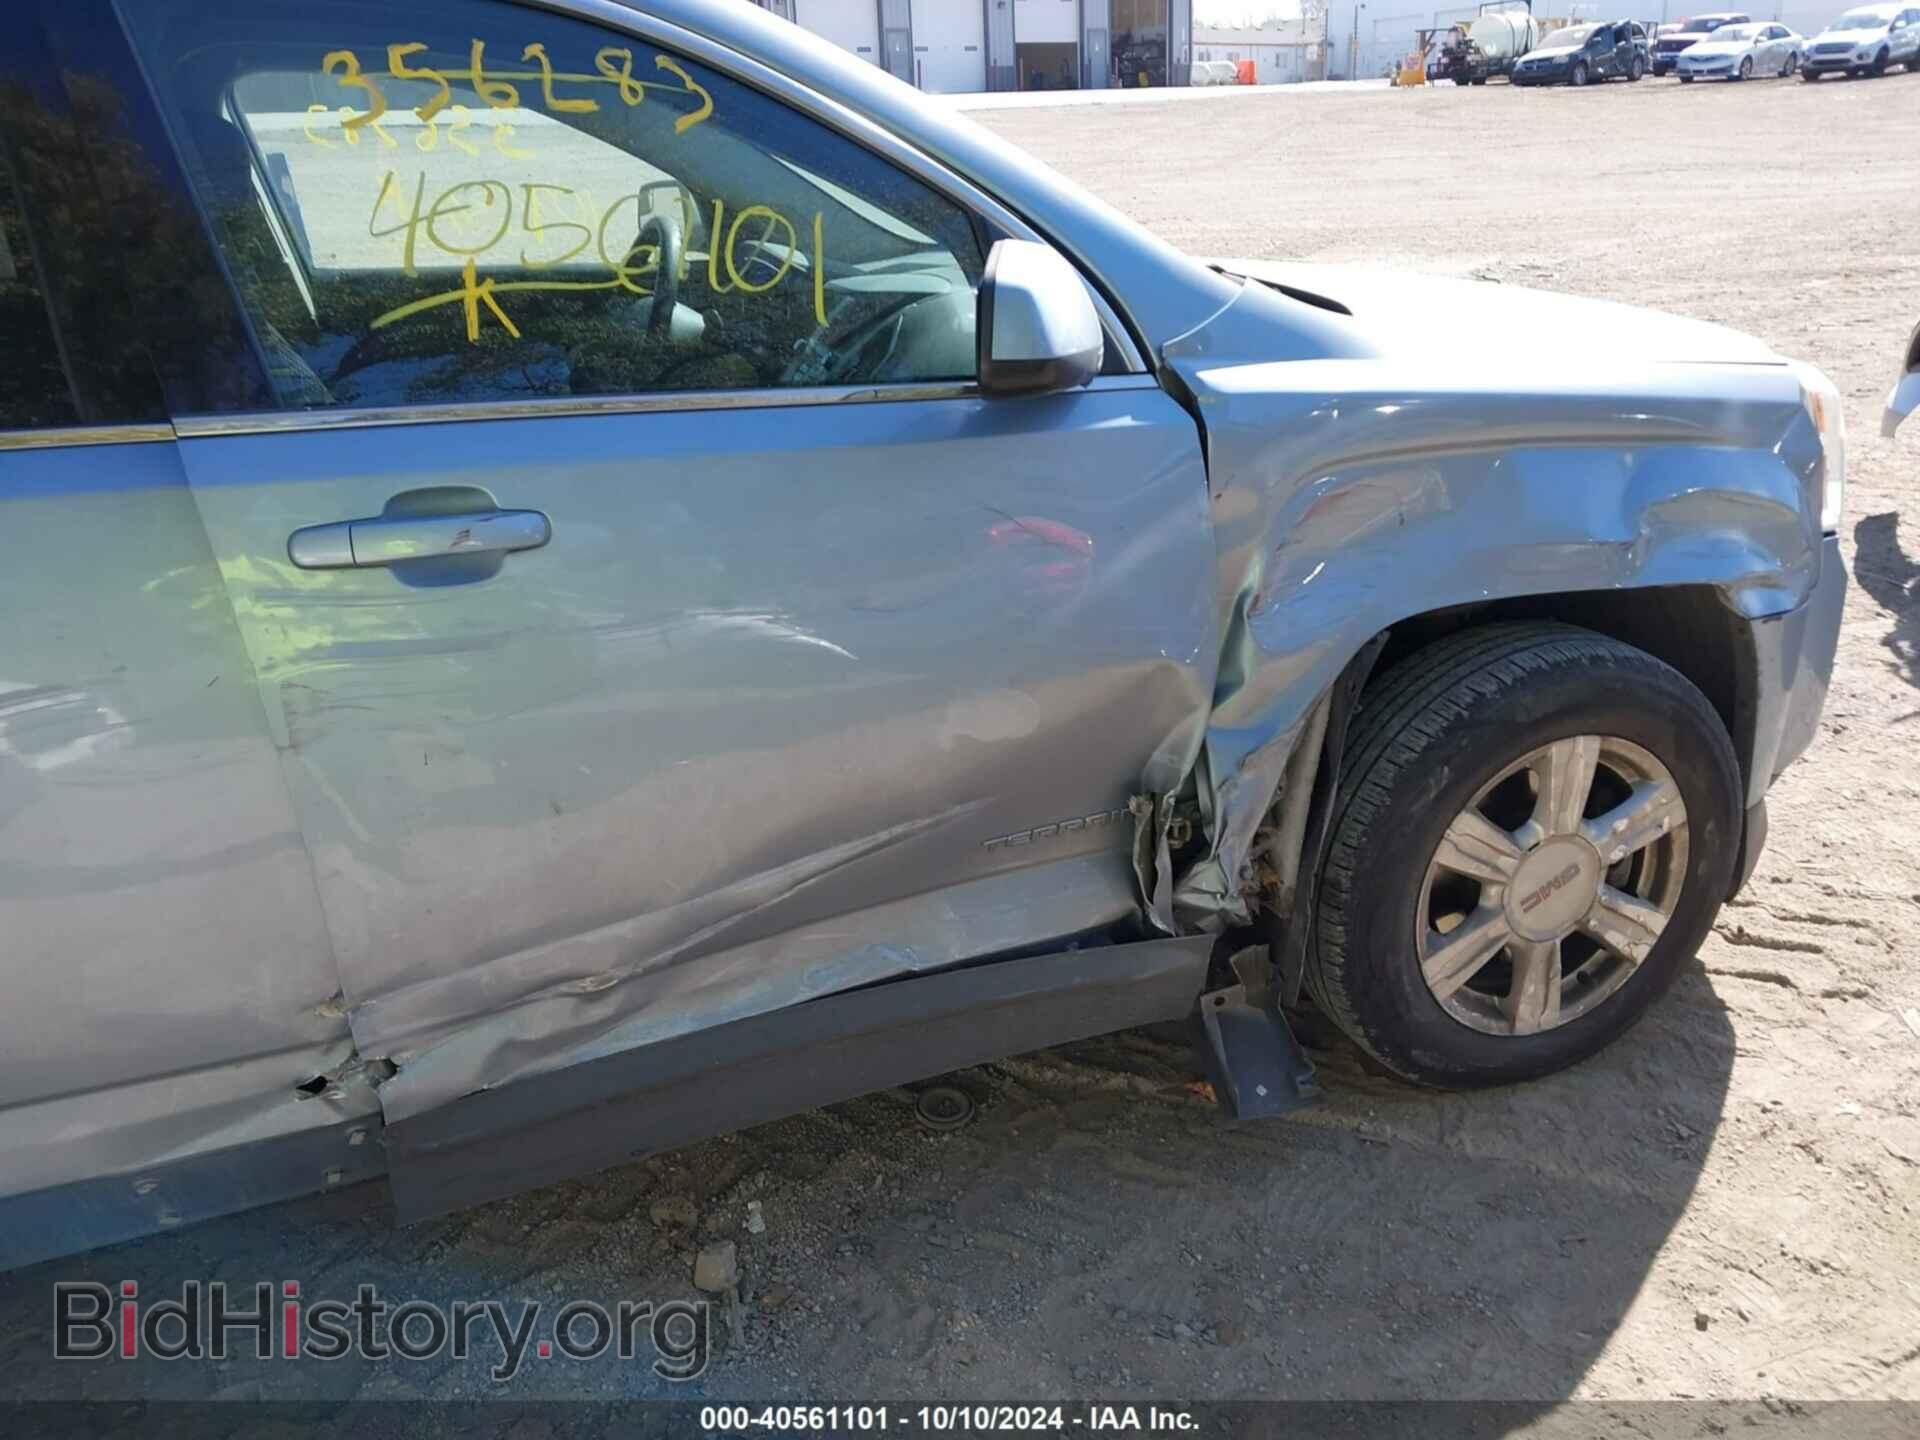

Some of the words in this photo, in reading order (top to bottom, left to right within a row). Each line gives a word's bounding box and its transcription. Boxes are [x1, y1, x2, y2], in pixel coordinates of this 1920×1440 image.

[322, 39, 713, 137] 356283
[369, 170, 829, 328] 40561101
[1519, 862, 1581, 914] GMC
